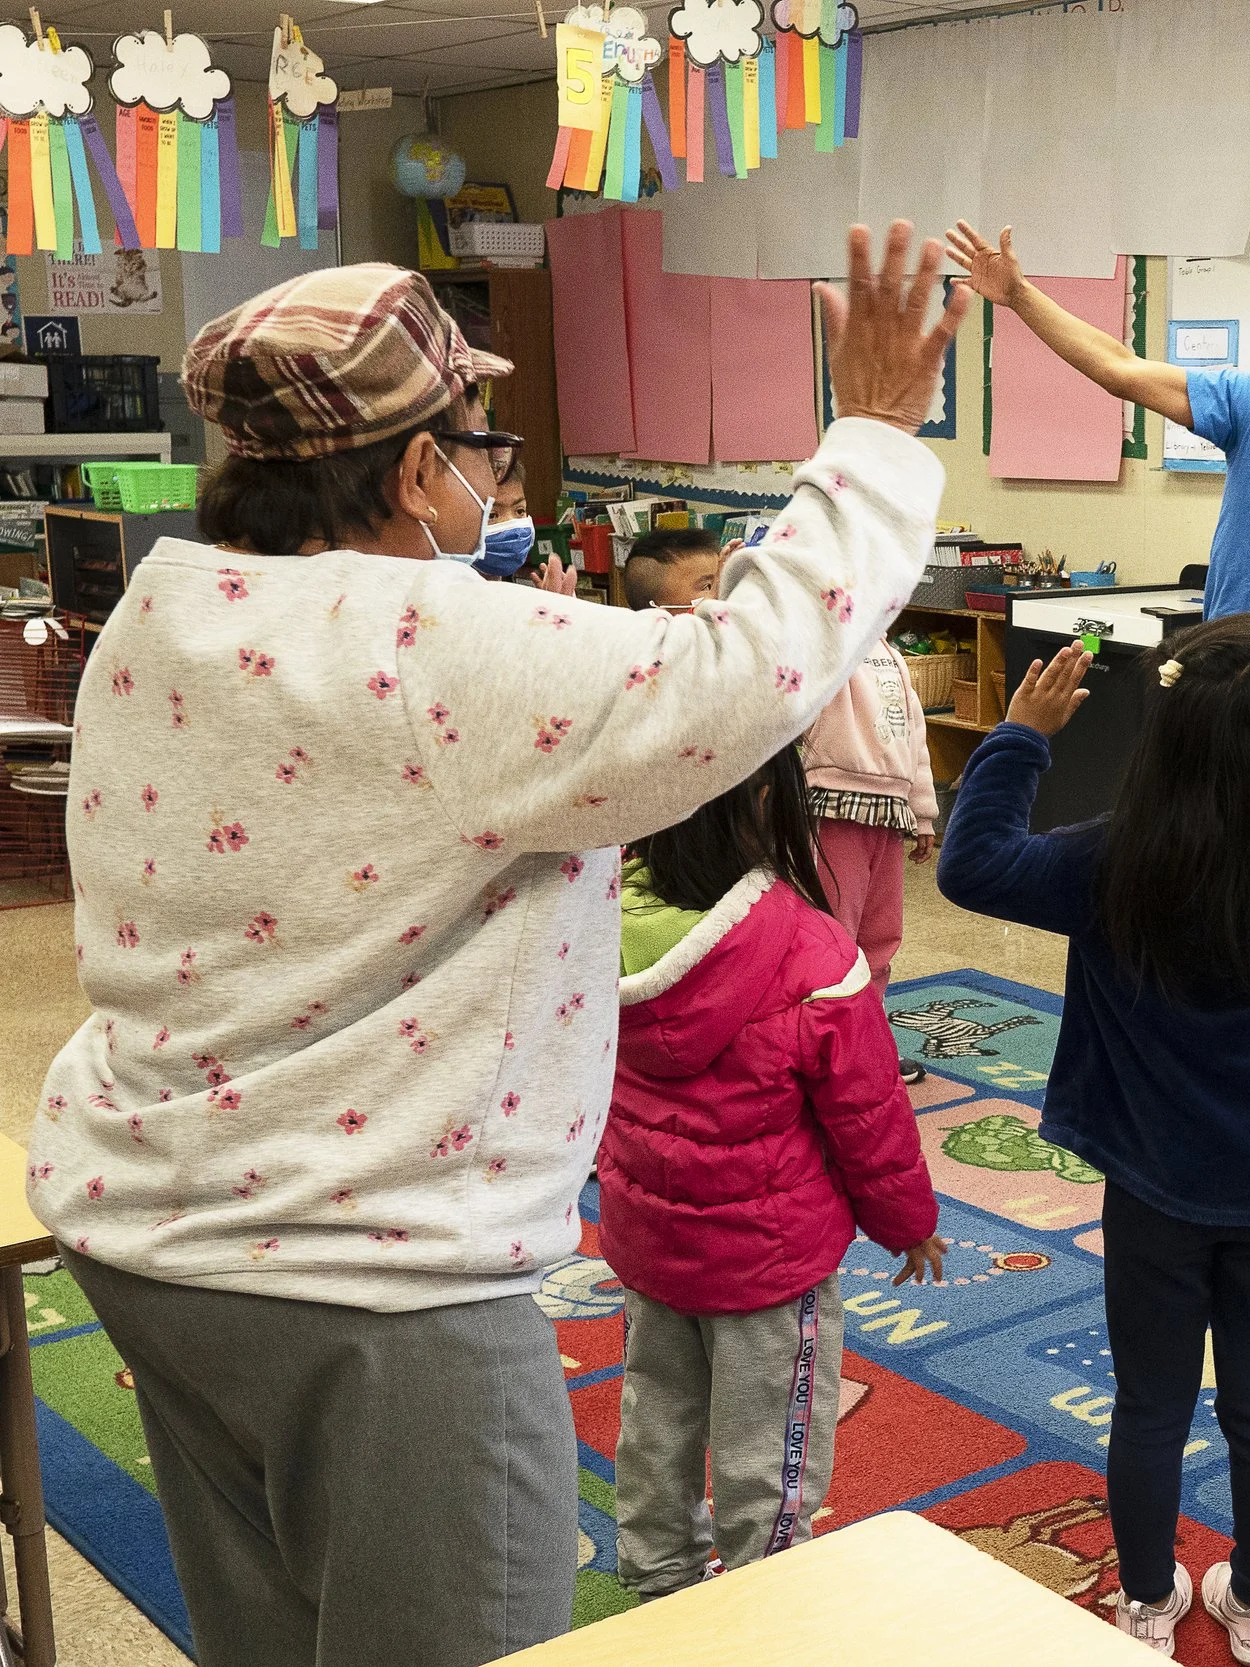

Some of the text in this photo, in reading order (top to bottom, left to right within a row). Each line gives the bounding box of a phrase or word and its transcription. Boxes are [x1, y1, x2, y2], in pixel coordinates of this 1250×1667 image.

[566, 48, 595, 105] 5
[53, 291, 105, 308] READ!
[802, 1286, 816, 1316] YOU
[795, 1337, 814, 1405] LOVE YOU
[786, 1422, 805, 1490] LOVE YOU
[775, 1512, 796, 1544] LOVE
